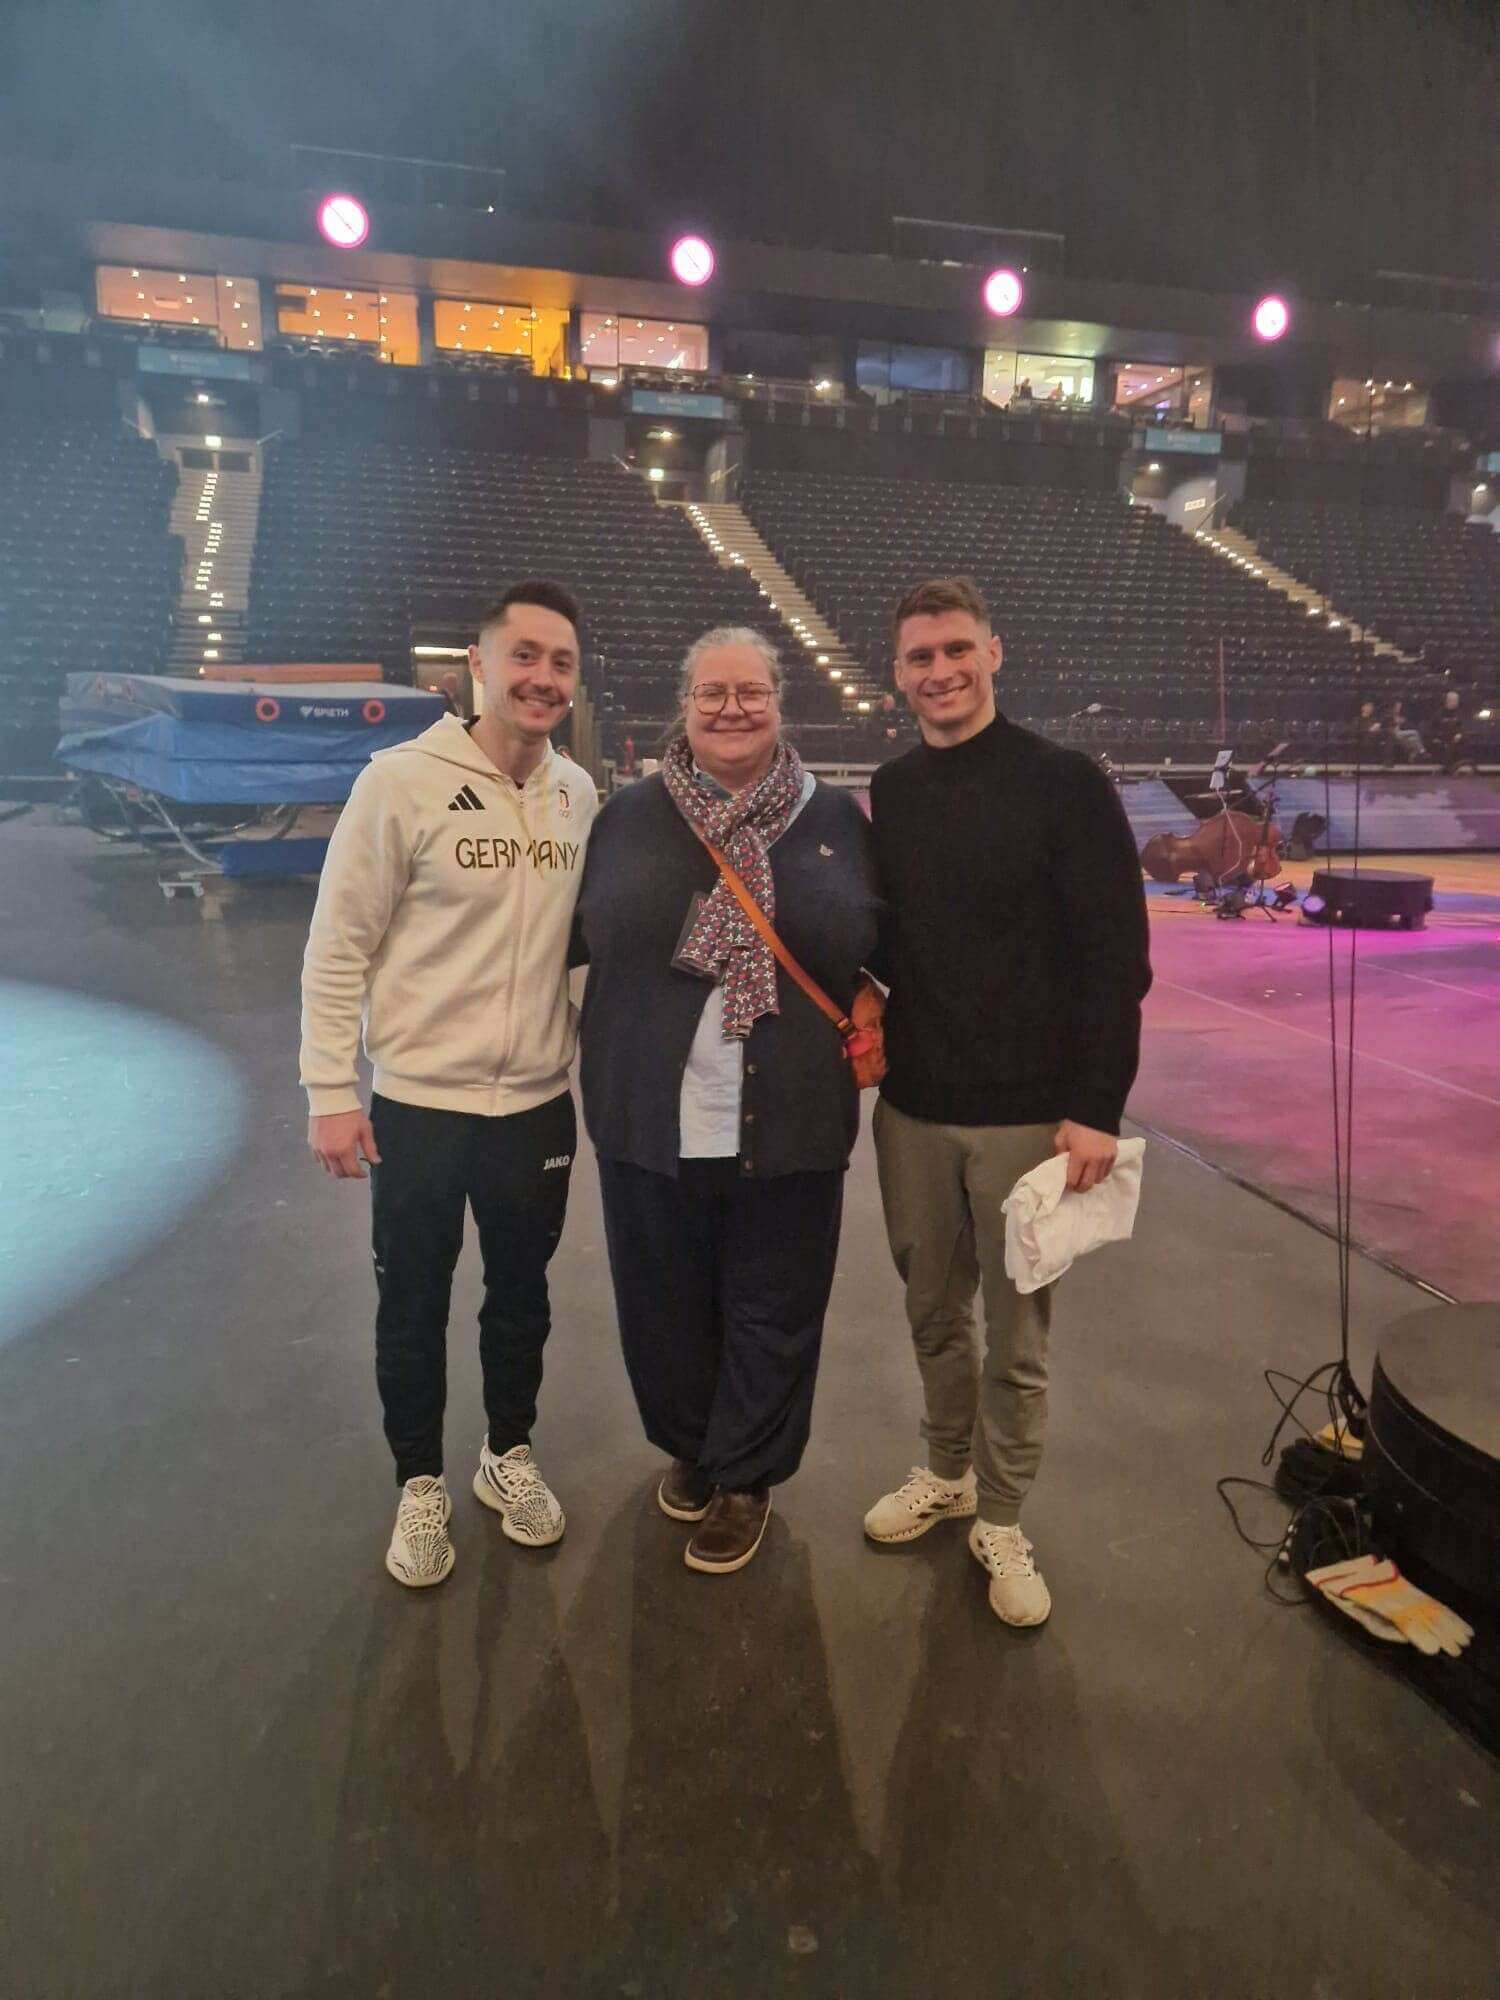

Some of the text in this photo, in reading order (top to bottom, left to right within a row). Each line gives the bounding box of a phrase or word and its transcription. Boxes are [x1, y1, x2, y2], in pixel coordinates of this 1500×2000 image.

[313, 705, 350, 718] SPIETH
[455, 837, 580, 871] GERMANY
[543, 1154, 571, 1171] JAKO
